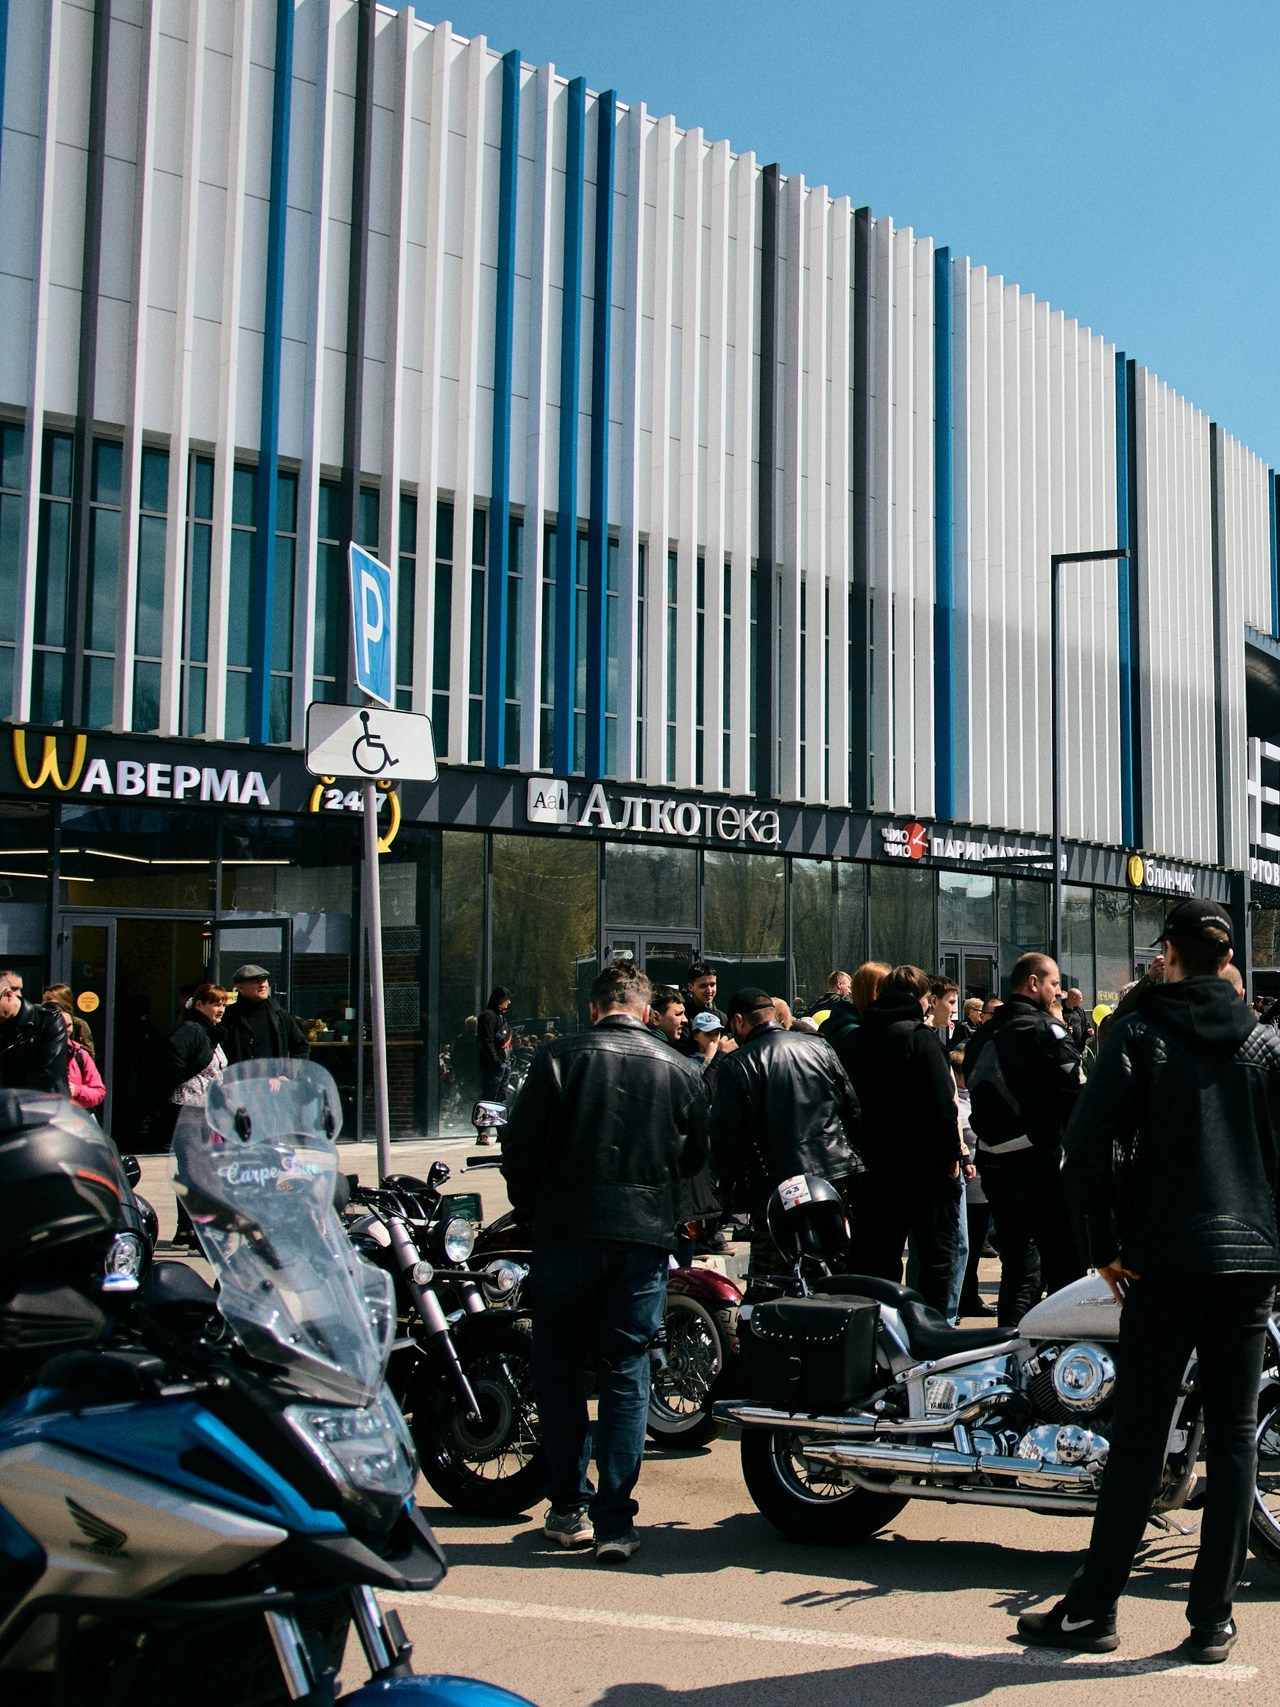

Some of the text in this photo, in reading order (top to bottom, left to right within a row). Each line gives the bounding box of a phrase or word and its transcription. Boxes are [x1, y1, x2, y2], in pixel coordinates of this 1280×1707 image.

[361, 568, 384, 675] P
[881, 828, 909, 843] ЧИО
[884, 842, 912, 858] ЧИО
[217, 1162, 279, 1188] Carpe
[929, 1402, 954, 1410] YAMAHA
